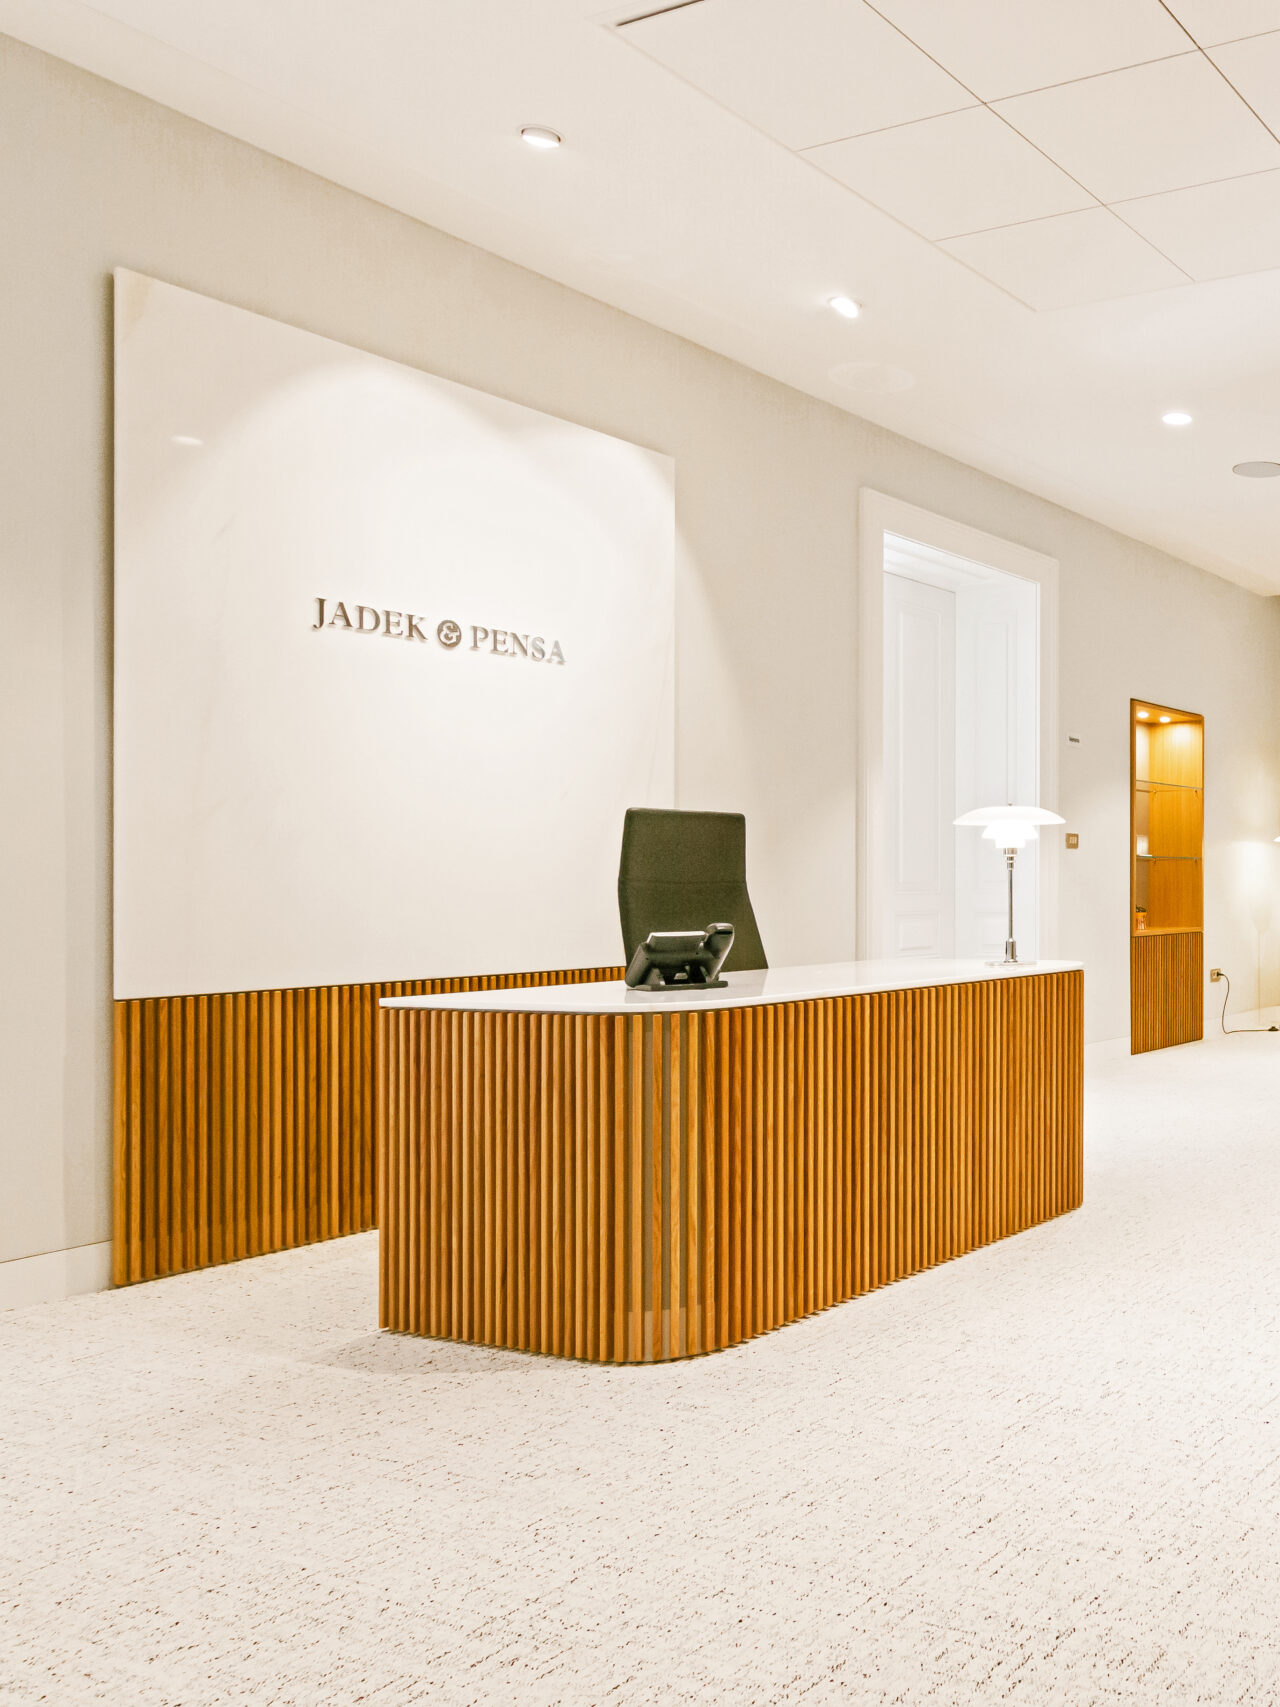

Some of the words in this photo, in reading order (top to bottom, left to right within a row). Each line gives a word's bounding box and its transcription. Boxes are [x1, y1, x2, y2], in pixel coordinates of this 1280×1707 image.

[312, 597, 428, 641] JADEK
[437, 620, 462, 648] &
[471, 625, 566, 665] PENSA
